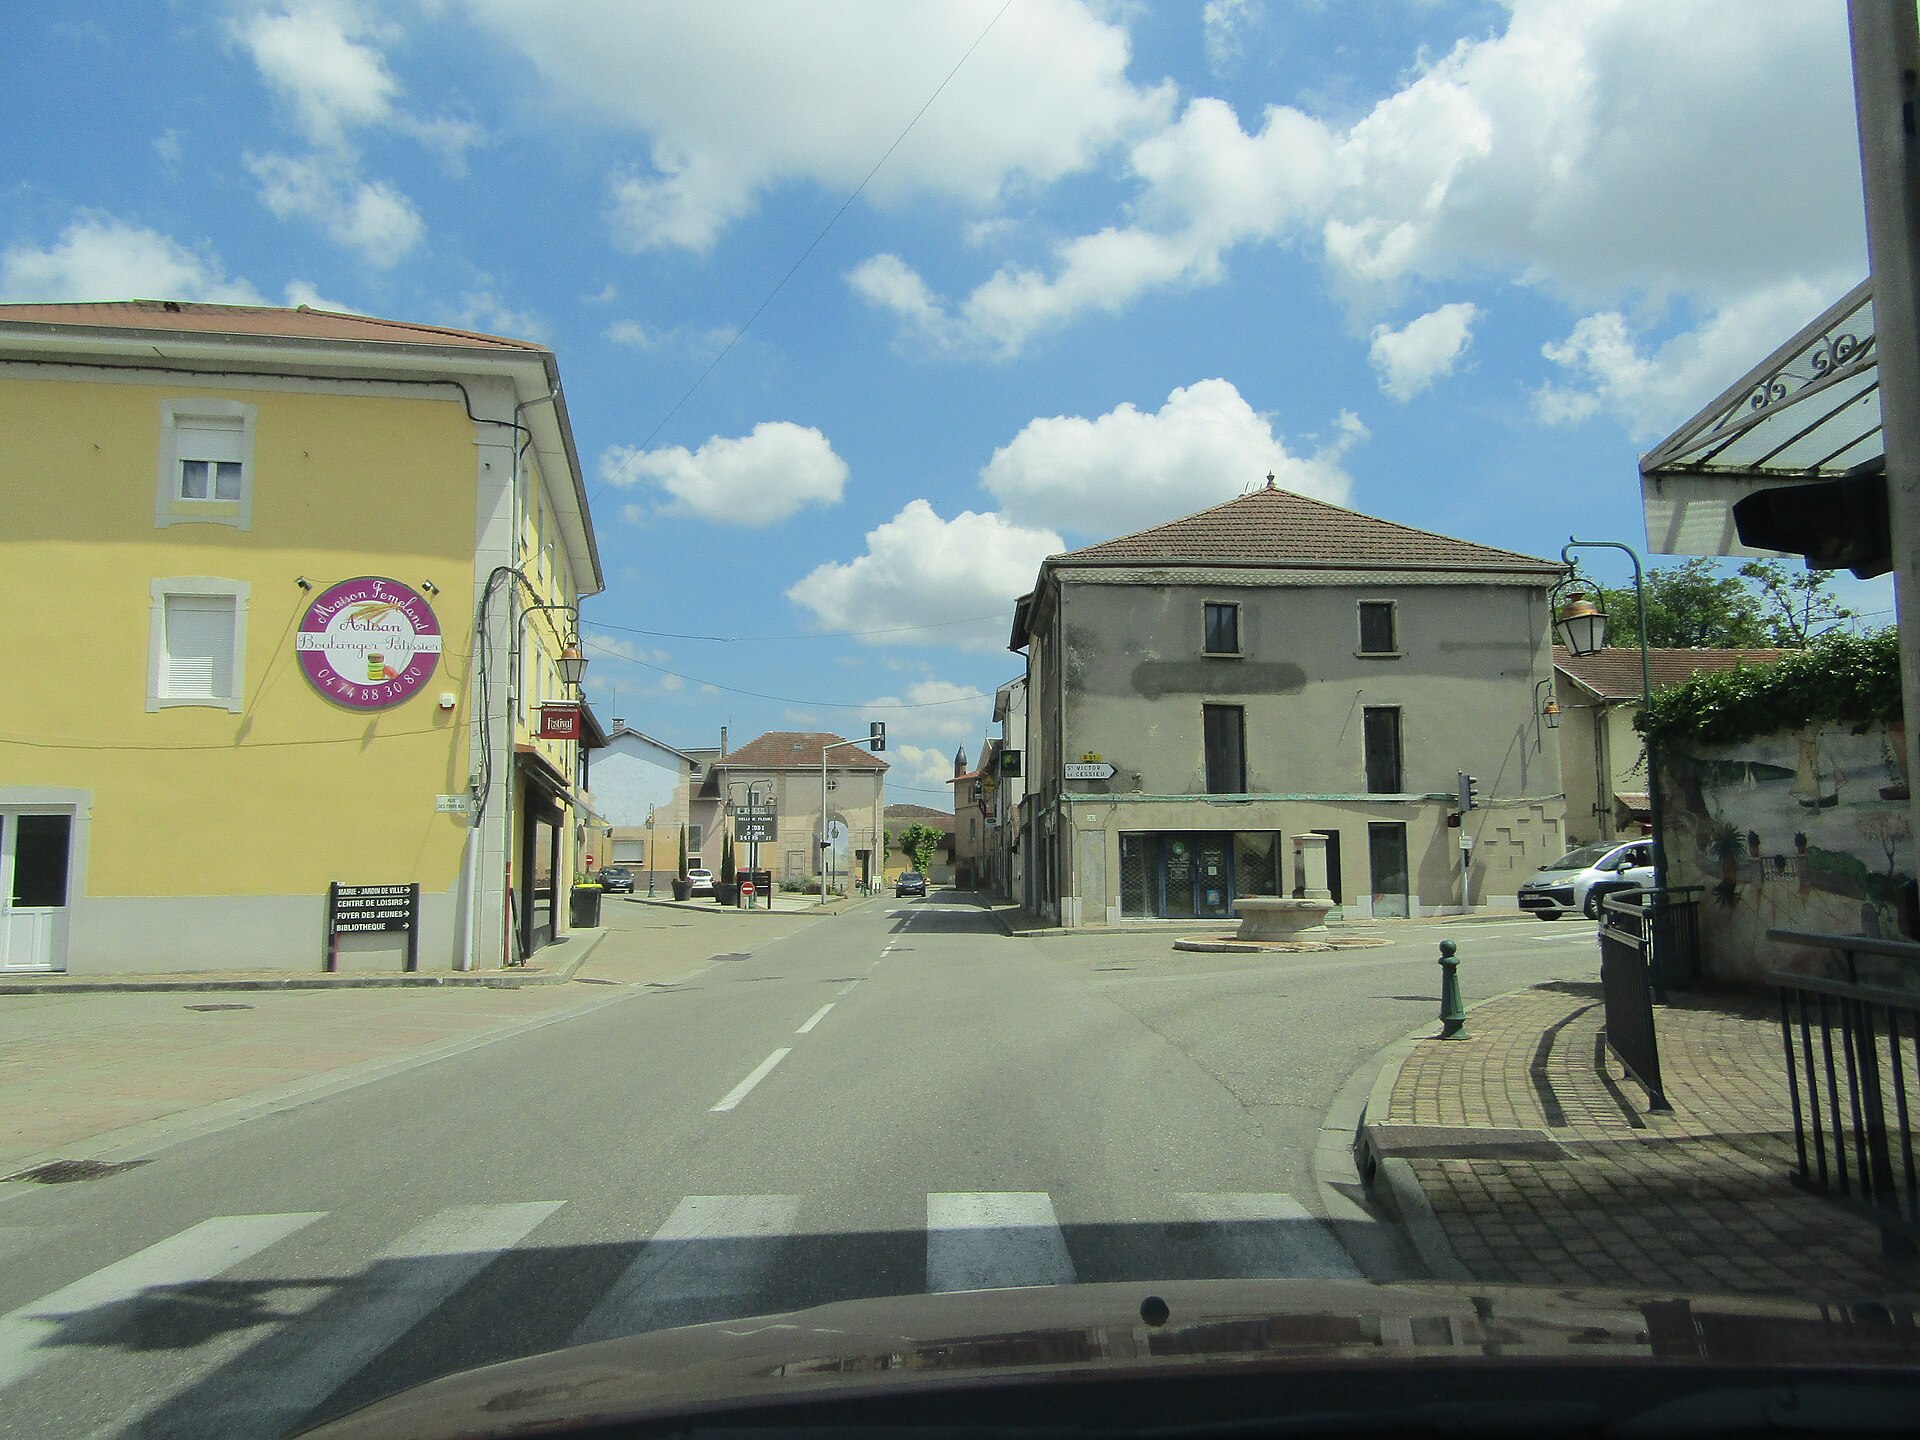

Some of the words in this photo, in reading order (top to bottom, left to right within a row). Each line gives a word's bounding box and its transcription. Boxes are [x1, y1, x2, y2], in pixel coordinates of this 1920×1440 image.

[313, 590, 367, 624] Maison
[372, 580, 429, 631] Femeland
[340, 614, 401, 632] Artisan
[298, 633, 378, 659] Boulanger
[318, 668, 336, 686] 04
[337, 683, 356, 698] 74
[361, 689, 379, 700] 88
[385, 682, 402, 697] 30
[404, 667, 421, 684] 80
[361, 887, 380, 895] JARDIN
[337, 899, 364, 907] CENTRE
[376, 898, 403, 906] LOISIRS
[337, 911, 360, 919] FOYER
[376, 910, 403, 918] JEUNES
[336, 922, 386, 931] BIBLIOTHEQUE
